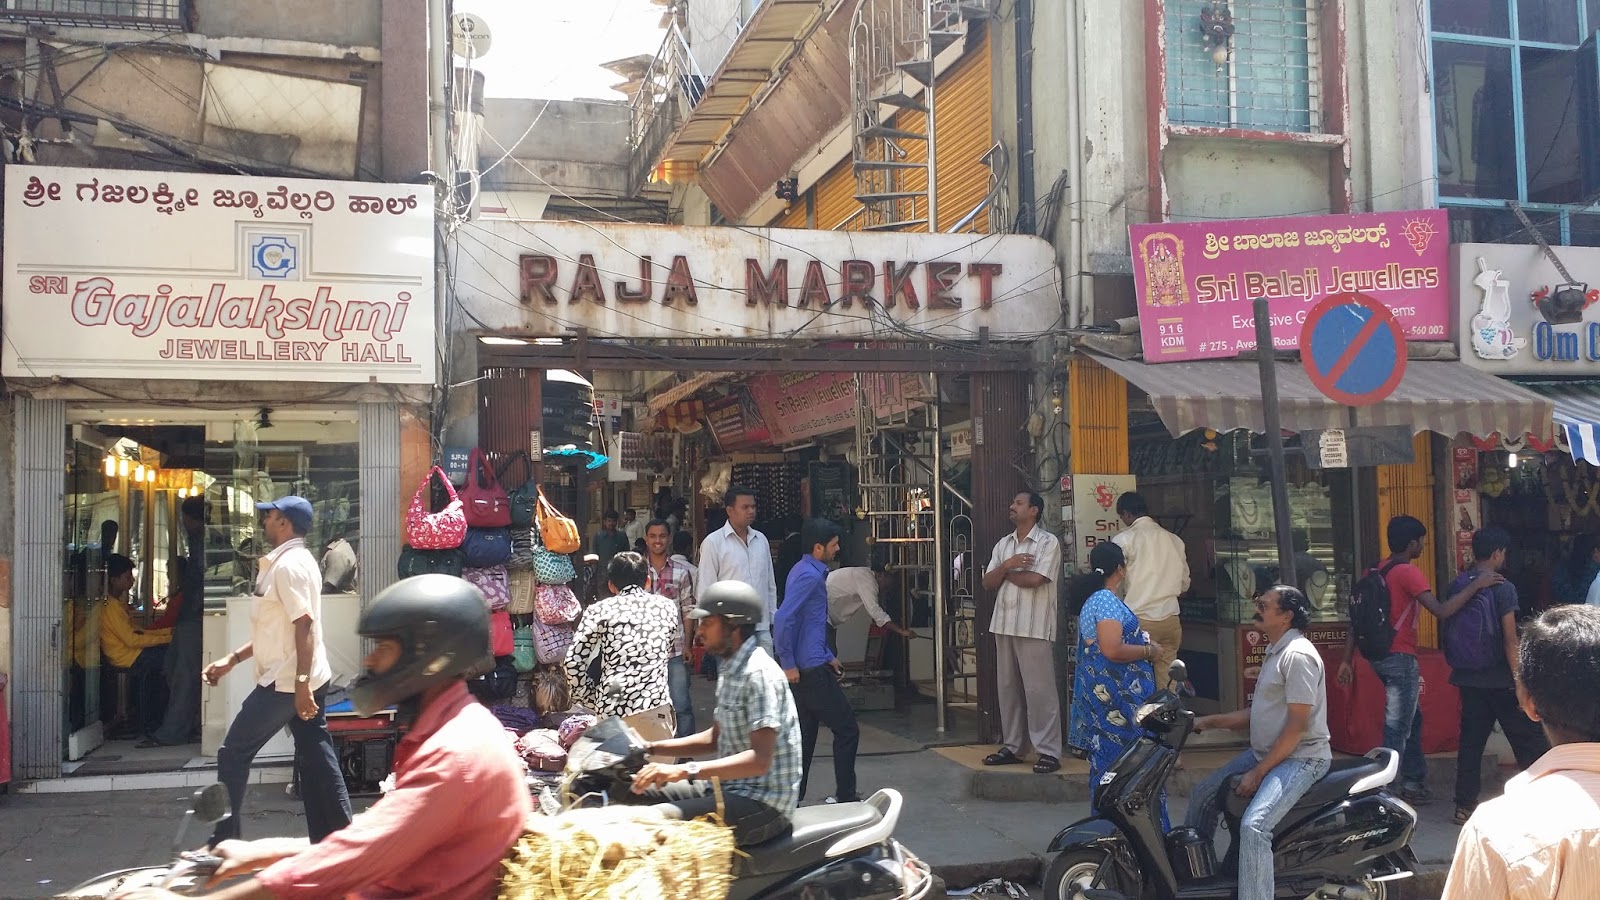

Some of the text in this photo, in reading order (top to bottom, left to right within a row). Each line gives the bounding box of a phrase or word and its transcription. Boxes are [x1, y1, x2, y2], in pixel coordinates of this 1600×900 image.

[23, 176, 61, 207] ಶ್ರೀ
[348, 194, 417, 215] ಹಾಲ್
[1203, 232, 1229, 259] ಶ್ರೀ
[1233, 231, 1300, 250] ಬಾಲಾಜಿ
[519, 253, 1003, 309] RAJA MARKET
[1195, 263, 1439, 303] Sri Balaji Jewellers
[29, 275, 411, 341] SRI Gajalakshmi
[1232, 313, 1292, 329] Excsive
[1411, 326, 1426, 335] 560
[1428, 325, 1444, 335] 002
[159, 338, 411, 363] JEWELLERY HALL
[1161, 336, 1184, 347] KDM
[1236, 340, 1256, 349] Ave
[1273, 336, 1298, 346] Road
[1533, 321, 1579, 361] Om
[787, 388, 816, 413] Balaji
[1095, 519, 1119, 531] Sri
[1310, 631, 1348, 641] JEWELLE
[1252, 646, 1266, 655] GOL
